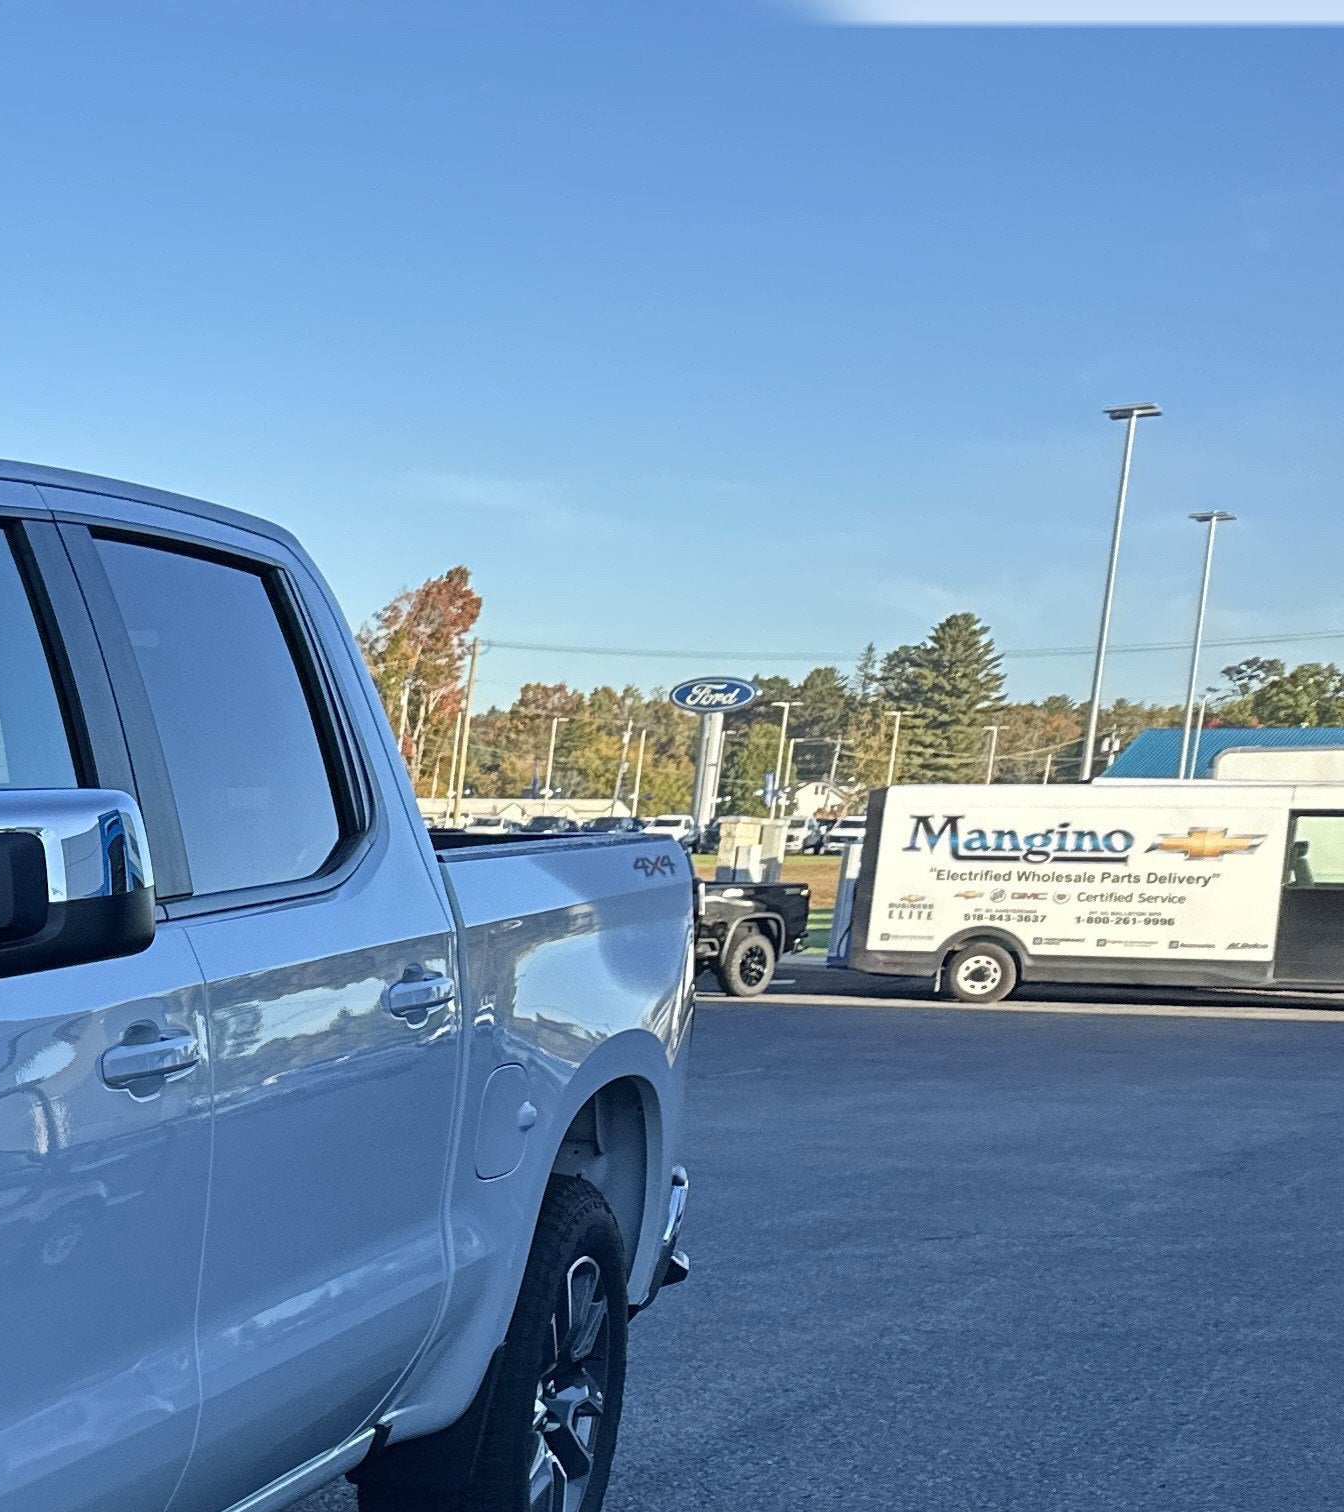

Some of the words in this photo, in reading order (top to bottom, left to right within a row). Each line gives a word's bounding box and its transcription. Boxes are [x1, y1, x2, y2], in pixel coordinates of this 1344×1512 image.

[685, 683, 741, 706] Ford
[901, 813, 1135, 865] Mangino
[1016, 870, 1097, 883] Wholesale
[1100, 871, 1141, 884] Parts
[1010, 891, 1049, 901] GMC
[1077, 891, 1133, 904] Certified
[1137, 892, 1187, 905] Service
[888, 910, 934, 921] ELITE
